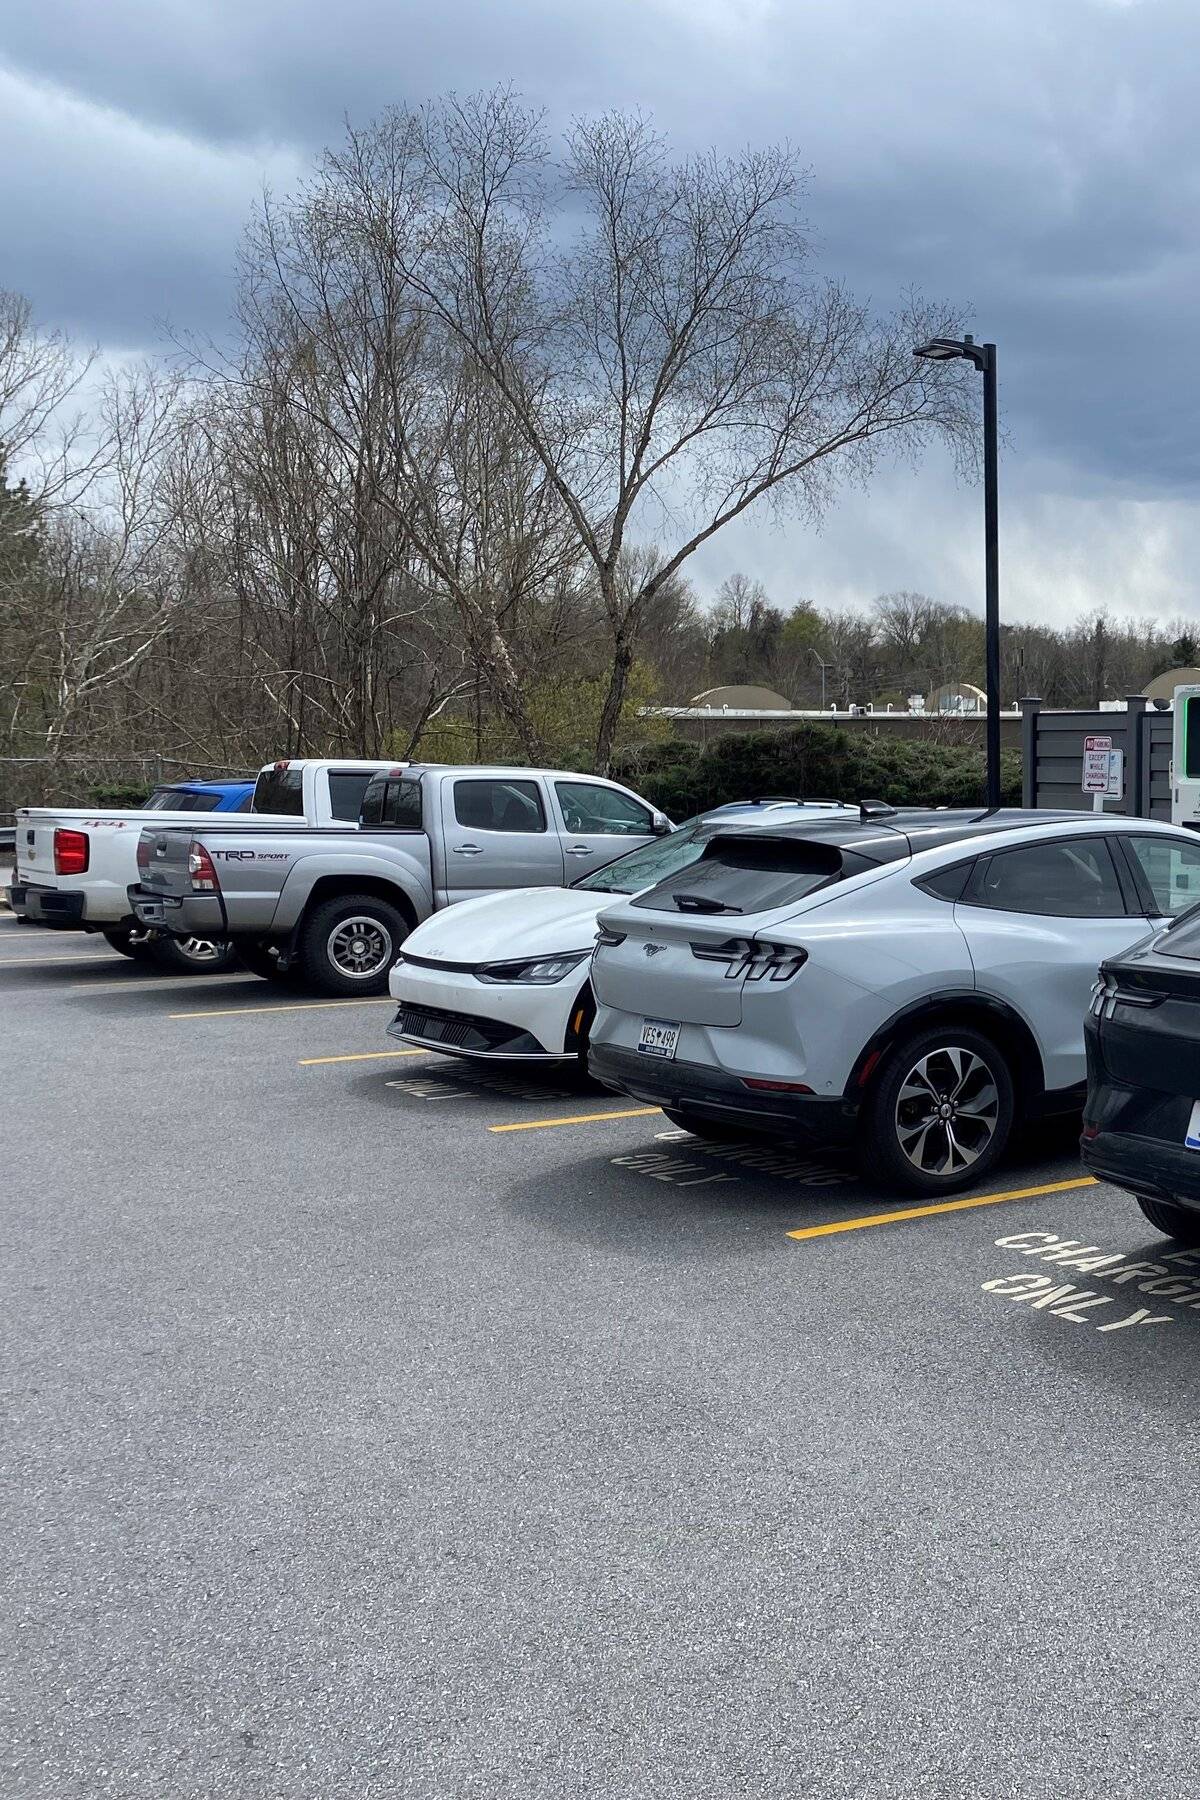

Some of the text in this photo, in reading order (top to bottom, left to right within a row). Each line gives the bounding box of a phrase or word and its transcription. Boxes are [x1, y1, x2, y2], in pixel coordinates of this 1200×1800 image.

[211, 850, 255, 861] TRD
[642, 1025, 676, 1049] VES 498
[384, 1078, 480, 1101] ONLY
[610, 1153, 741, 1187] ONLY
[980, 1273, 1174, 1333] ONLY
